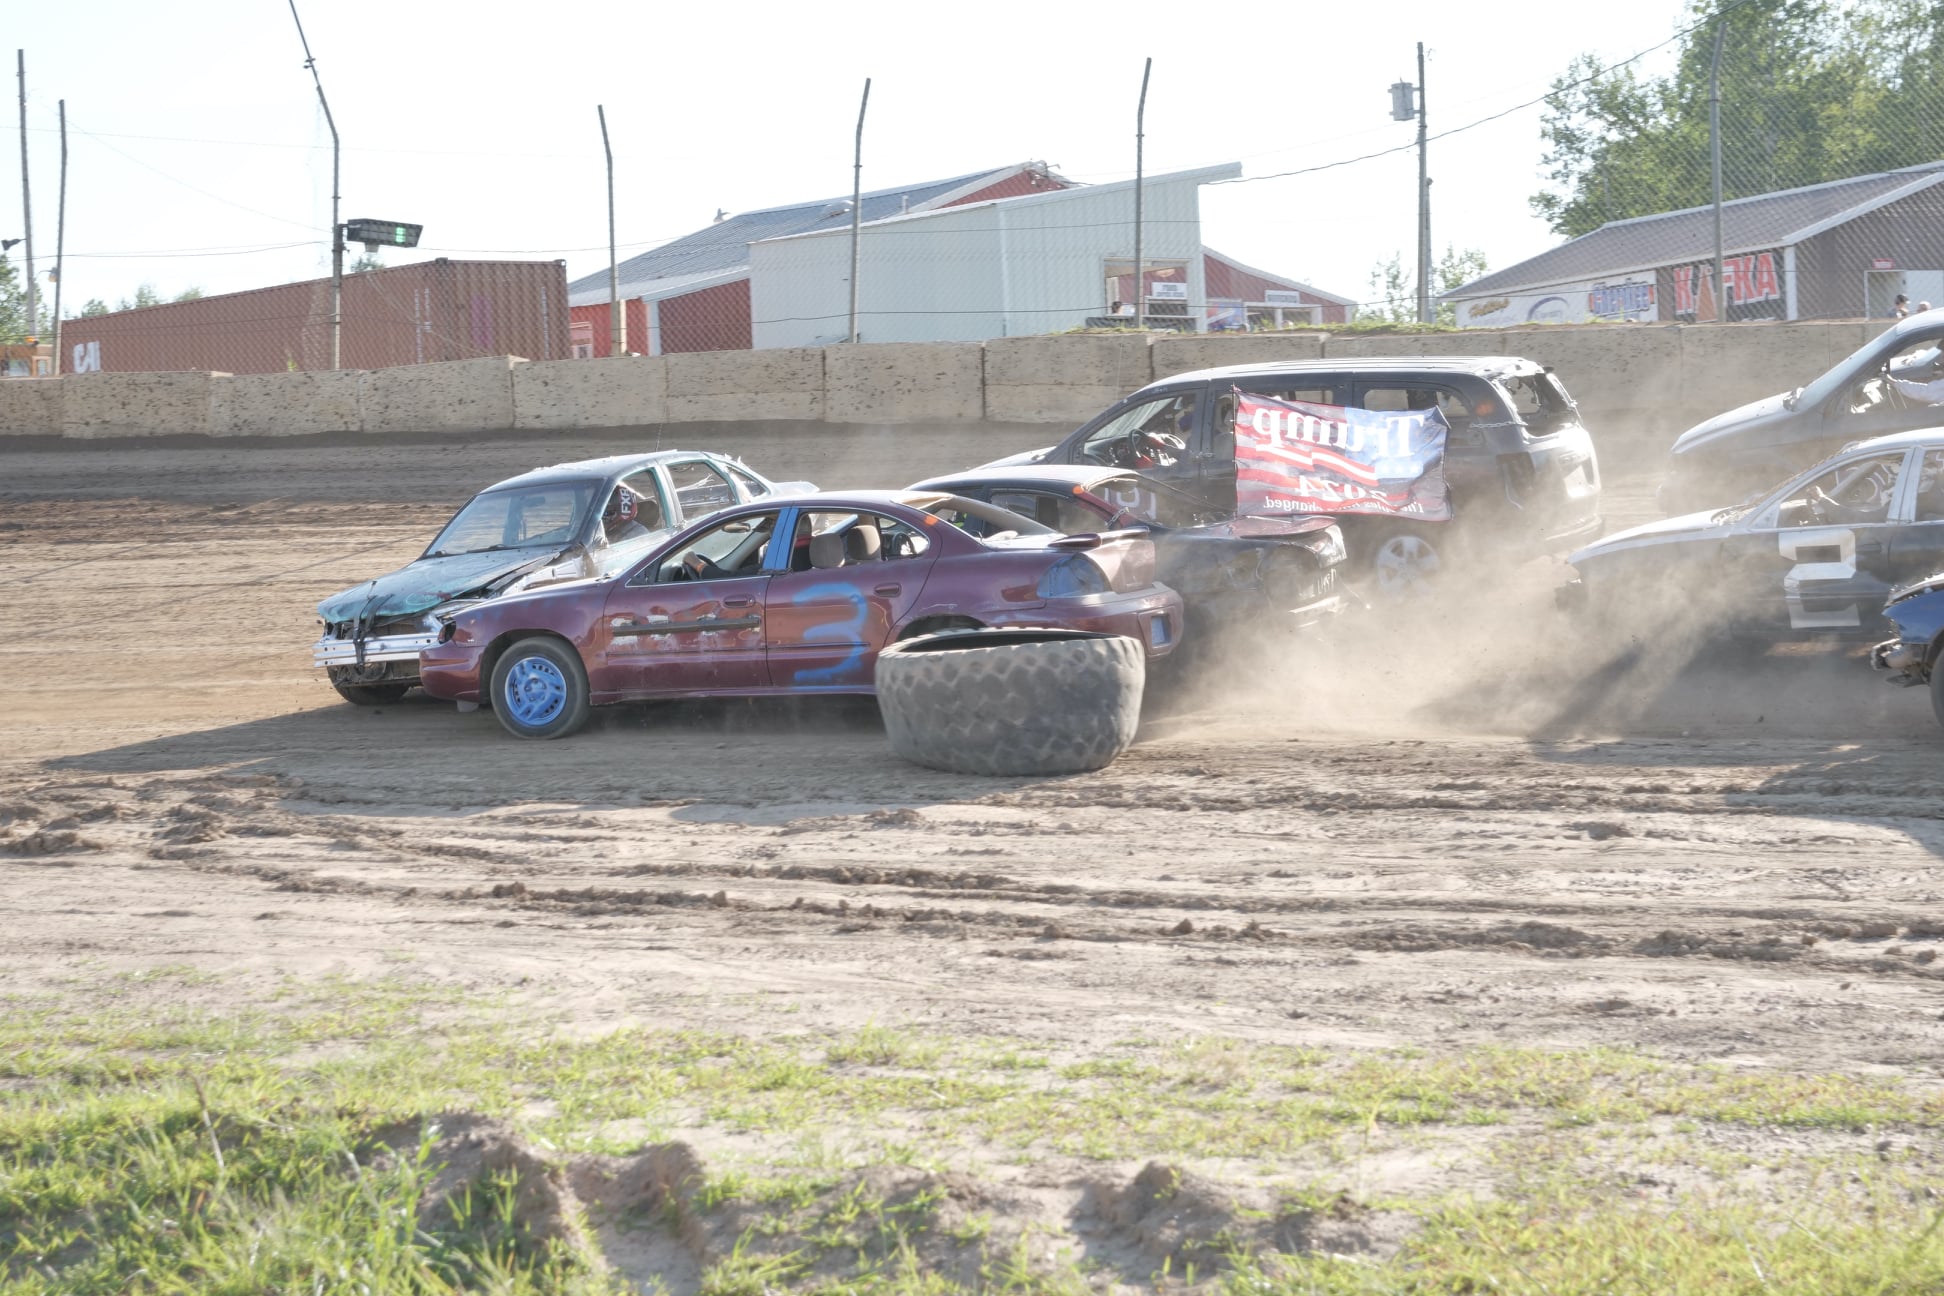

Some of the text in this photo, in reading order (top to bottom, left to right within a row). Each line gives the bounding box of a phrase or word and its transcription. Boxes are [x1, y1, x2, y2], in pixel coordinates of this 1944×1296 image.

[1673, 253, 1781, 321] KAFKA
[1778, 528, 1861, 629] 2
[791, 580, 869, 686] 3
